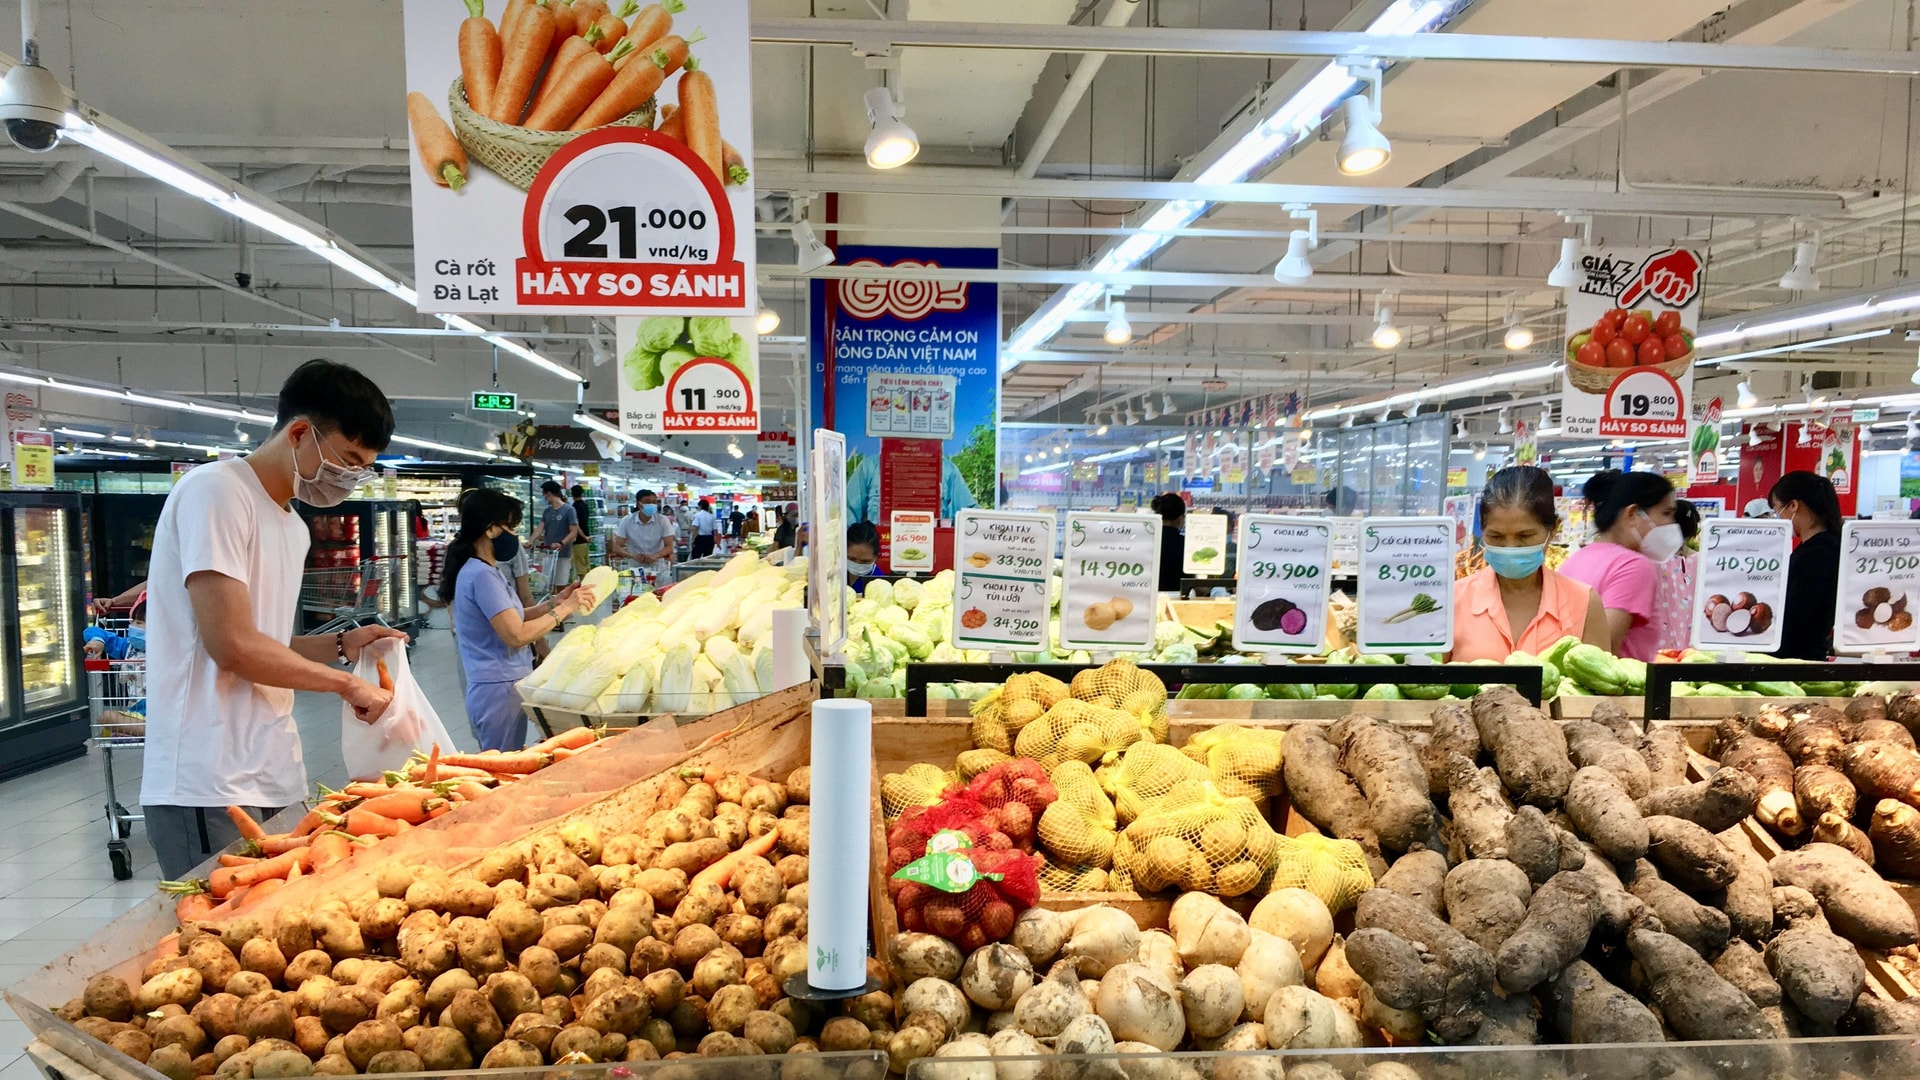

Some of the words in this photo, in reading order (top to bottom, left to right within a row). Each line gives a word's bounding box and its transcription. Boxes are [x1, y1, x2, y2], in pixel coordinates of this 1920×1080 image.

[648, 244, 708, 261] vnd/kg
[435, 258, 461, 276] Cà
[467, 257, 496, 276] rốt
[1582, 253, 1612, 272] GIÁ
[522, 267, 591, 295] HÃY
[598, 273, 642, 296] SO
[650, 269, 739, 297] SÁNH
[433, 284, 461, 300] Đà
[468, 285, 499, 304] Lạt
[836, 326, 863, 341] RÂN
[865, 329, 916, 345] TRỌNG
[919, 326, 952, 343] CẢM
[955, 330, 978, 343] ƠN
[876, 344, 908, 360] DÂN
[910, 344, 940, 363] VIỆT
[943, 348, 977, 361] NAM
[968, 367, 987, 375] cao
[665, 415, 695, 427] HÃY
[696, 416, 715, 427] SO
[718, 414, 755, 427] SÁNH
[1578, 416, 1597, 424] chua
[1601, 420, 1630, 432] HÃY
[1630, 422, 1647, 432] SO
[1650, 421, 1685, 434] SÁNH
[563, 440, 586, 450] mai
[983, 533, 1020, 542] VIETGAP
[1021, 536, 1035, 544] 1KG
[1863, 537, 1894, 547] KHOAI
[996, 554, 1042, 568] 33.900
[1080, 559, 1144, 578] 14.900
[1716, 556, 1780, 574] 40.900
[1856, 555, 1920, 574] 32.900
[1252, 561, 1319, 580] 39.900
[1378, 564, 1436, 581] 8.900
[983, 582, 1008, 591] KHOAI
[985, 591, 1000, 601] TÚI
[993, 616, 1039, 630] 34.900
